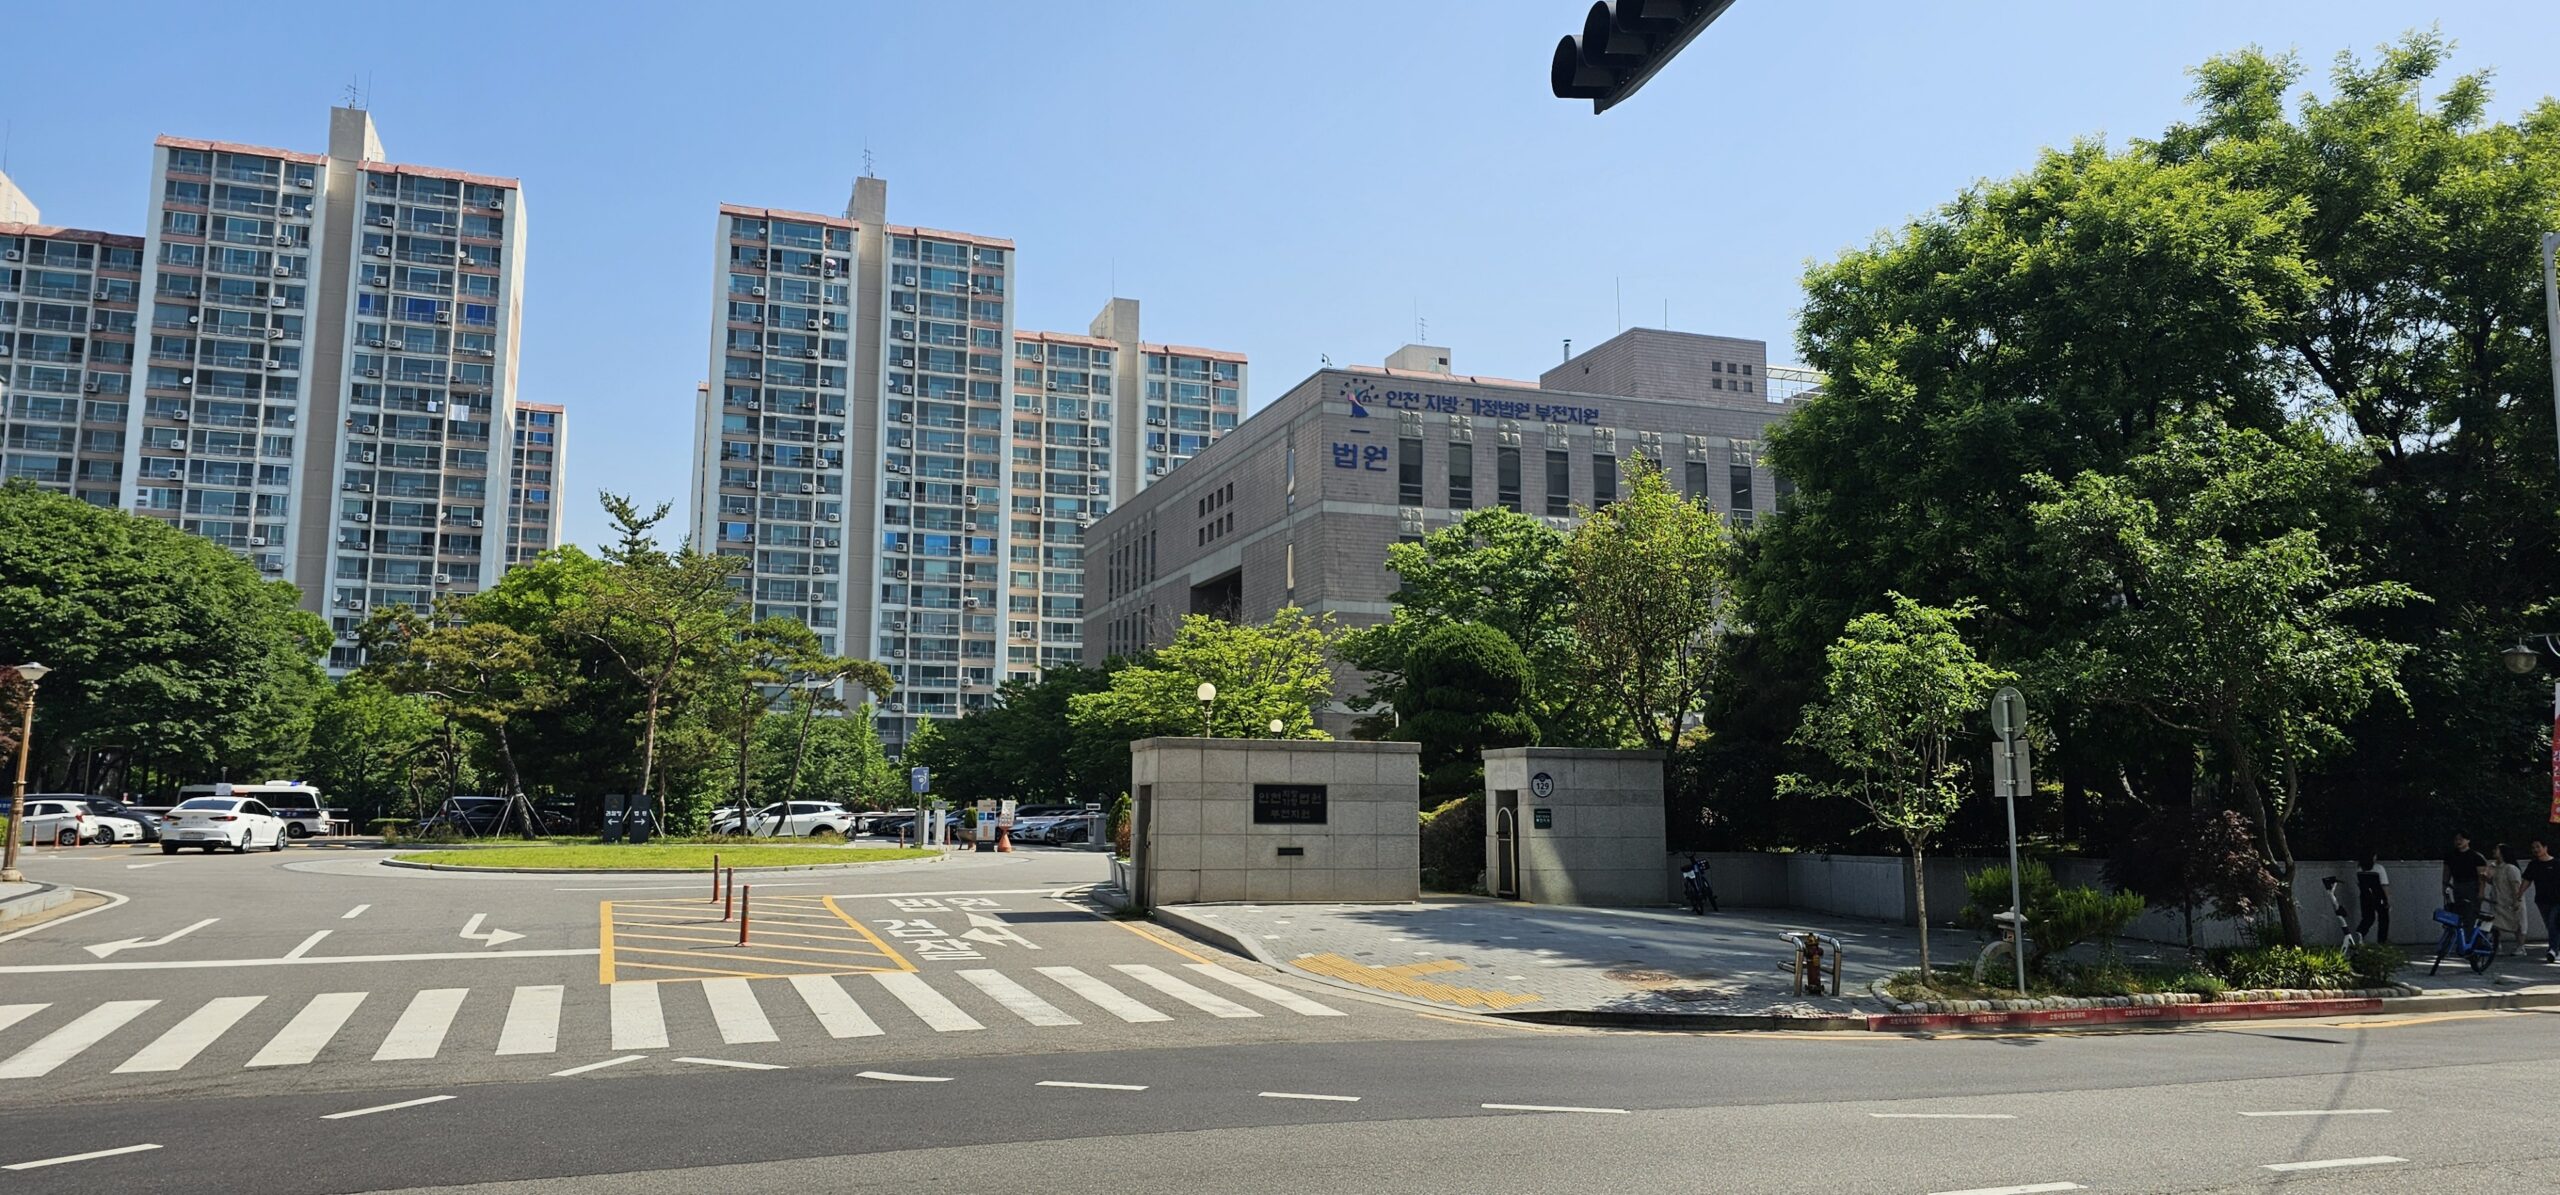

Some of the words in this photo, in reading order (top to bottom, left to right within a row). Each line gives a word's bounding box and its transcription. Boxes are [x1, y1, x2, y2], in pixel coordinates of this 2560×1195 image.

[1385, 390, 1420, 410] 인천
[1535, 403, 1599, 426] 부천지원
[1332, 442, 1388, 471] 법원
[1536, 782, 1549, 790] 129
[1270, 809, 1311, 819] 부천지원
[887, 897, 1013, 913] 법원
